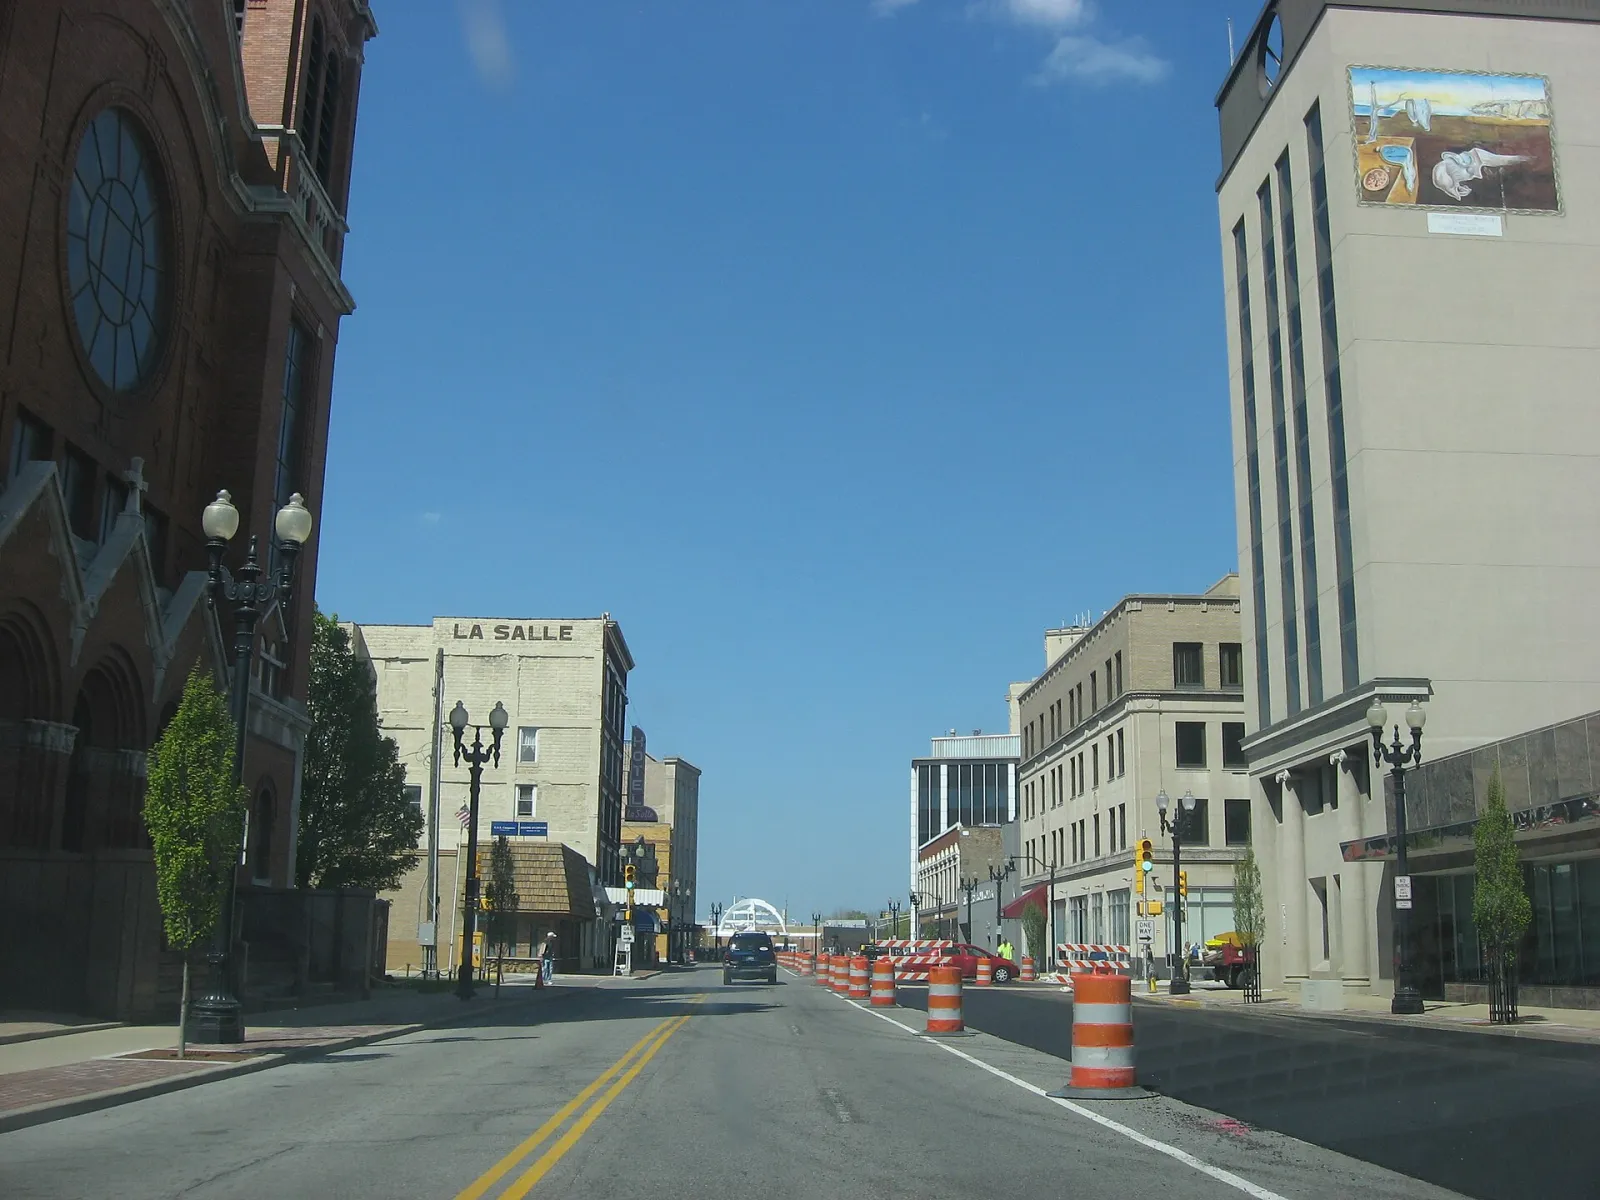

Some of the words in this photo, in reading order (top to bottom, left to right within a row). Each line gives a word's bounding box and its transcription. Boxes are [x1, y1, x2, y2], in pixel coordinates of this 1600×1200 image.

[453, 623, 484, 640] LA
[493, 624, 574, 641] SALLE
[632, 736, 644, 805] HOTEL
[1139, 921, 1152, 929] ONE
